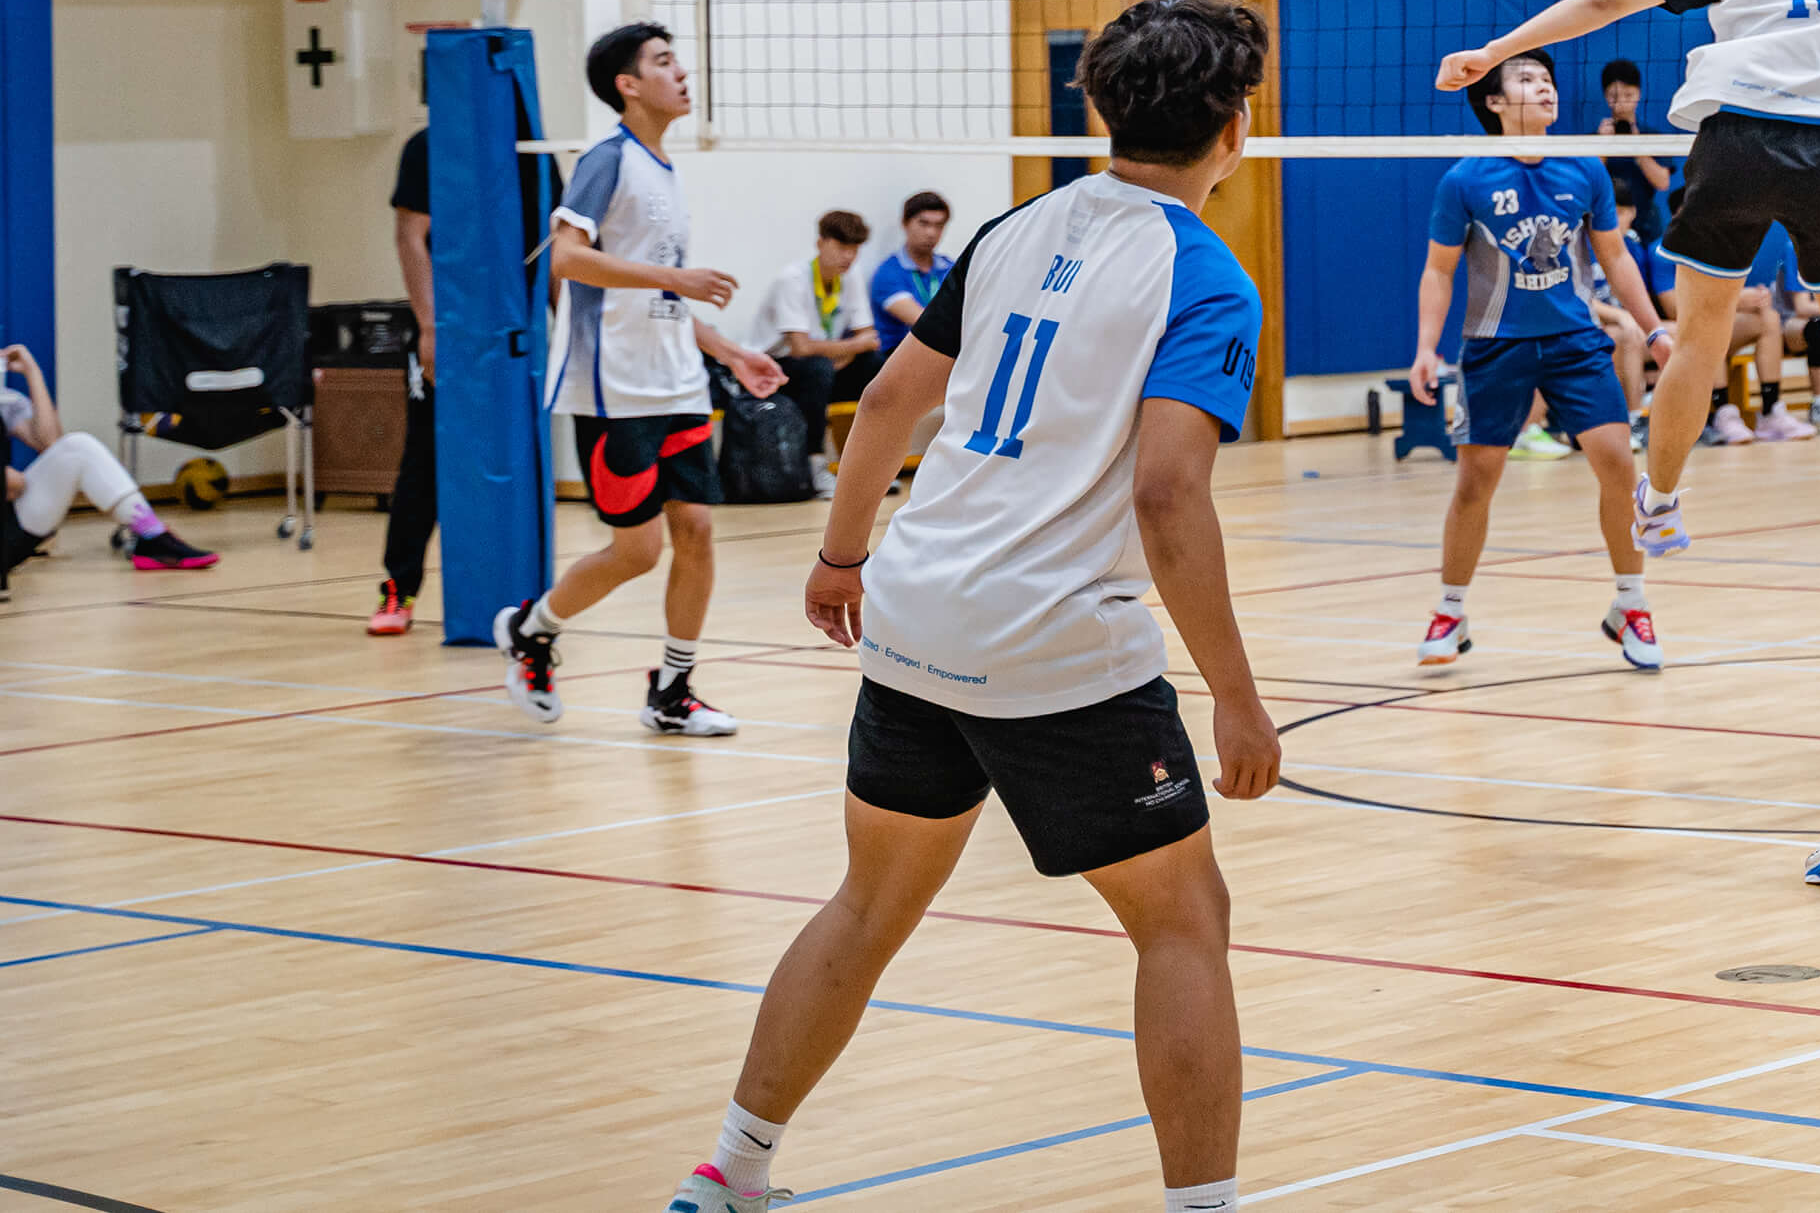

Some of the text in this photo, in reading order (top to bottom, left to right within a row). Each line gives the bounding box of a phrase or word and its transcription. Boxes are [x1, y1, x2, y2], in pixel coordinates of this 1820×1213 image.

[1491, 188, 1520, 216] 23
[1041, 254, 1084, 294] BUI
[1222, 337, 1256, 392] U19
[964, 312, 1060, 459] 11
[885, 647, 920, 669] Engaged
[927, 664, 988, 685] Empowered
